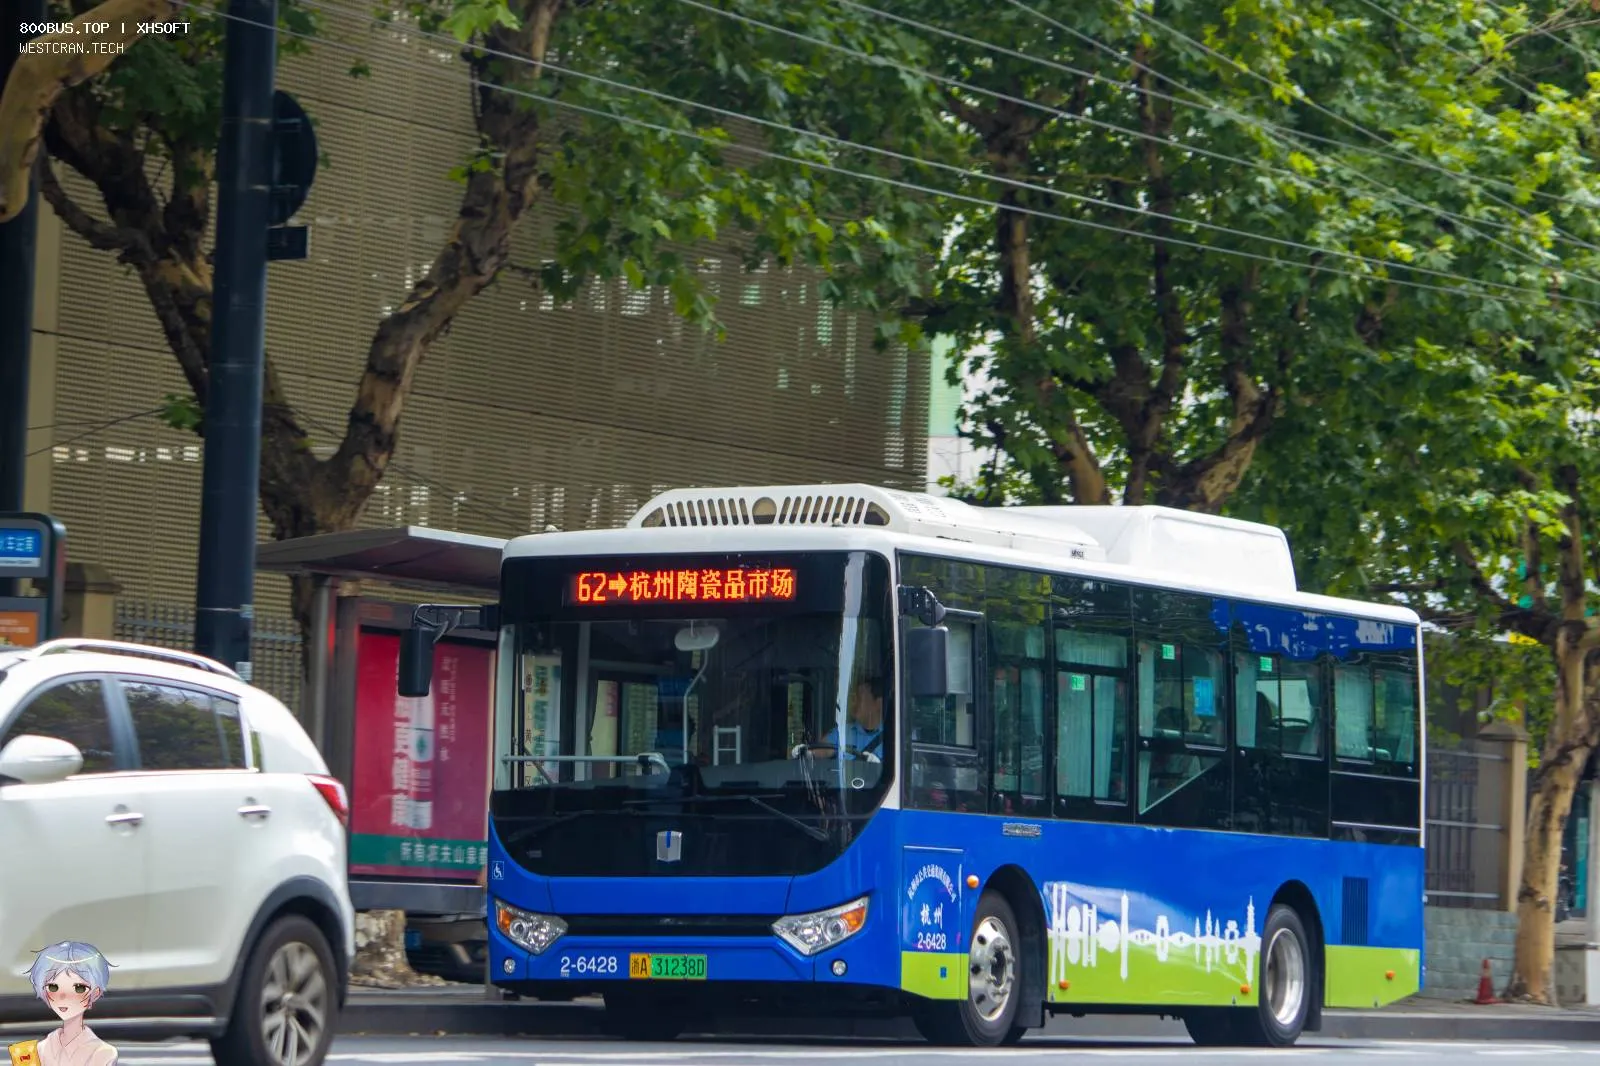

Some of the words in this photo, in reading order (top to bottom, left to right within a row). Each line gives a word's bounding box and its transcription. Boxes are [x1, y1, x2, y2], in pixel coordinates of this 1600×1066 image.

[578, 573, 606, 601] 62
[629, 569, 793, 599] 杭州陶瓷品市场
[918, 933, 946, 950] 2-6428
[560, 956, 618, 973] 2-6428
